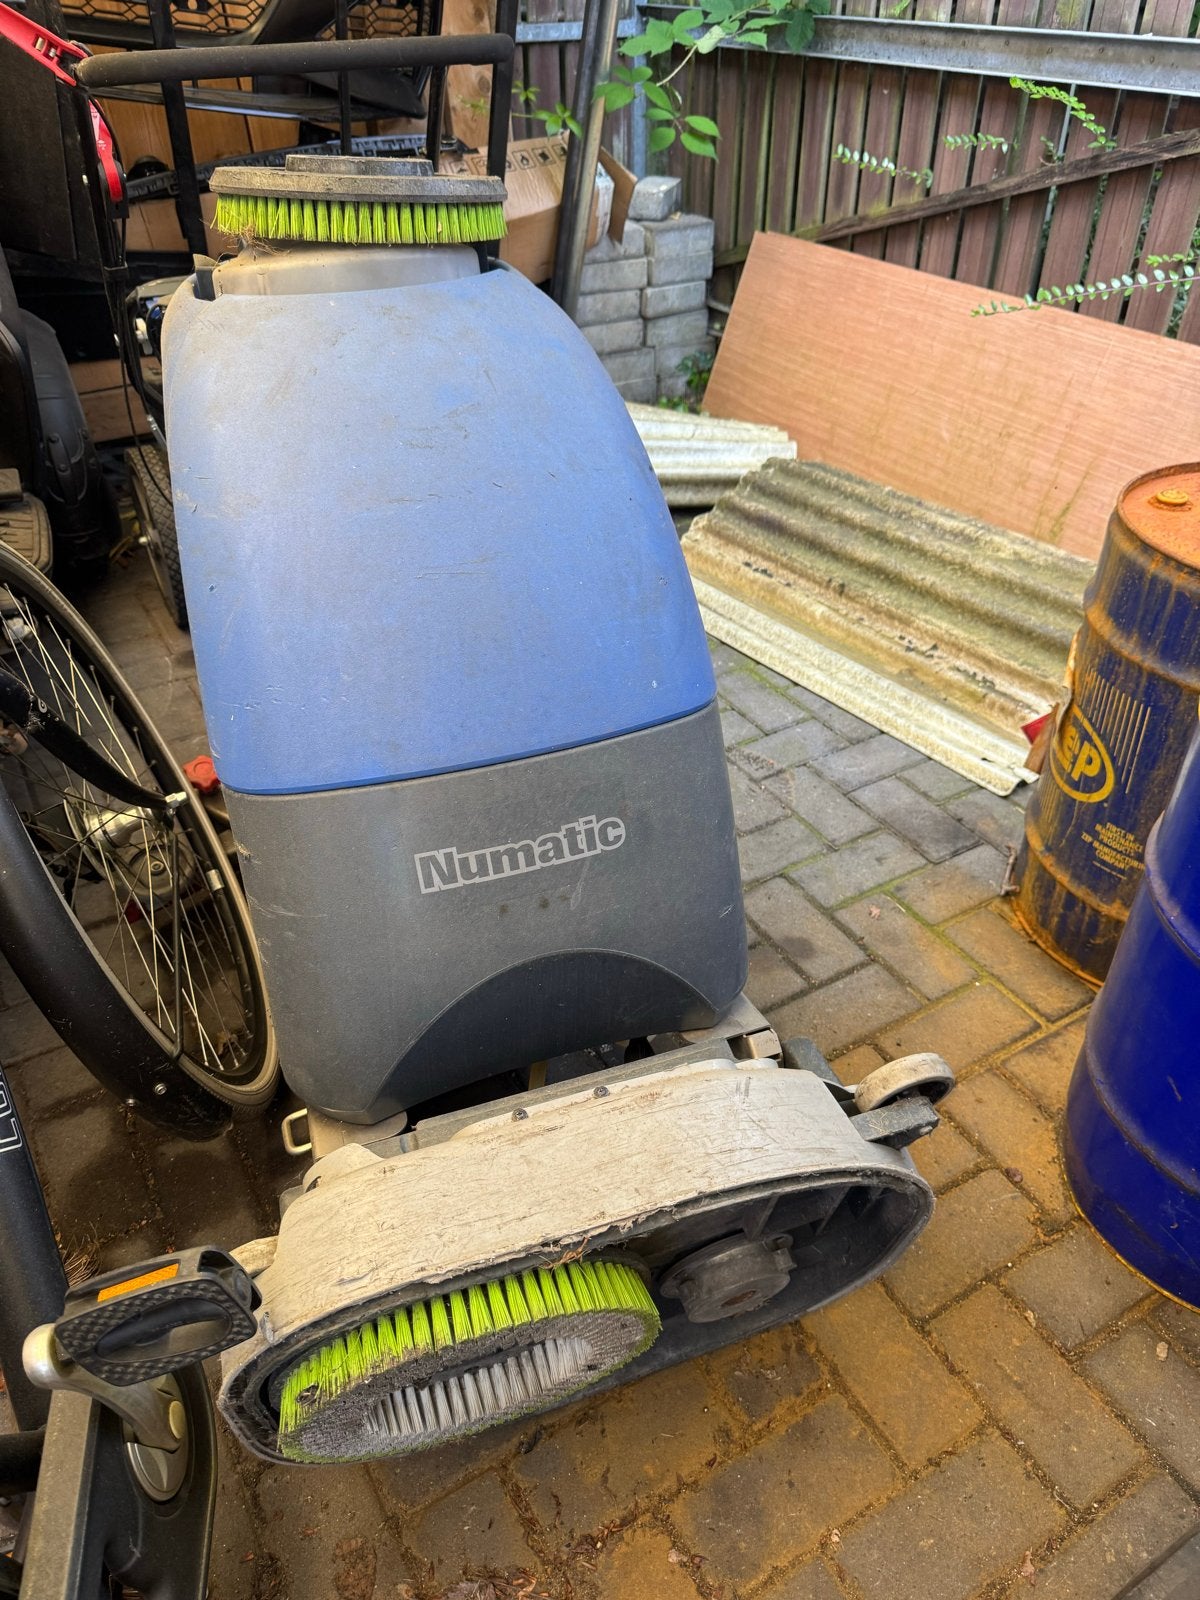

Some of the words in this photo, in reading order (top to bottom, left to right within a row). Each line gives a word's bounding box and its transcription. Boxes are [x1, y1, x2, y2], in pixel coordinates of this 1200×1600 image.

[1081, 831, 1093, 843] ZEP
[1095, 824, 1143, 853] MAINTENANCE
[1106, 822, 1126, 838] FIRST
[414, 815, 626, 894] Numatic
[1099, 833, 1134, 856] PRODUCTS
[1096, 849, 1130, 870] COMPANY
